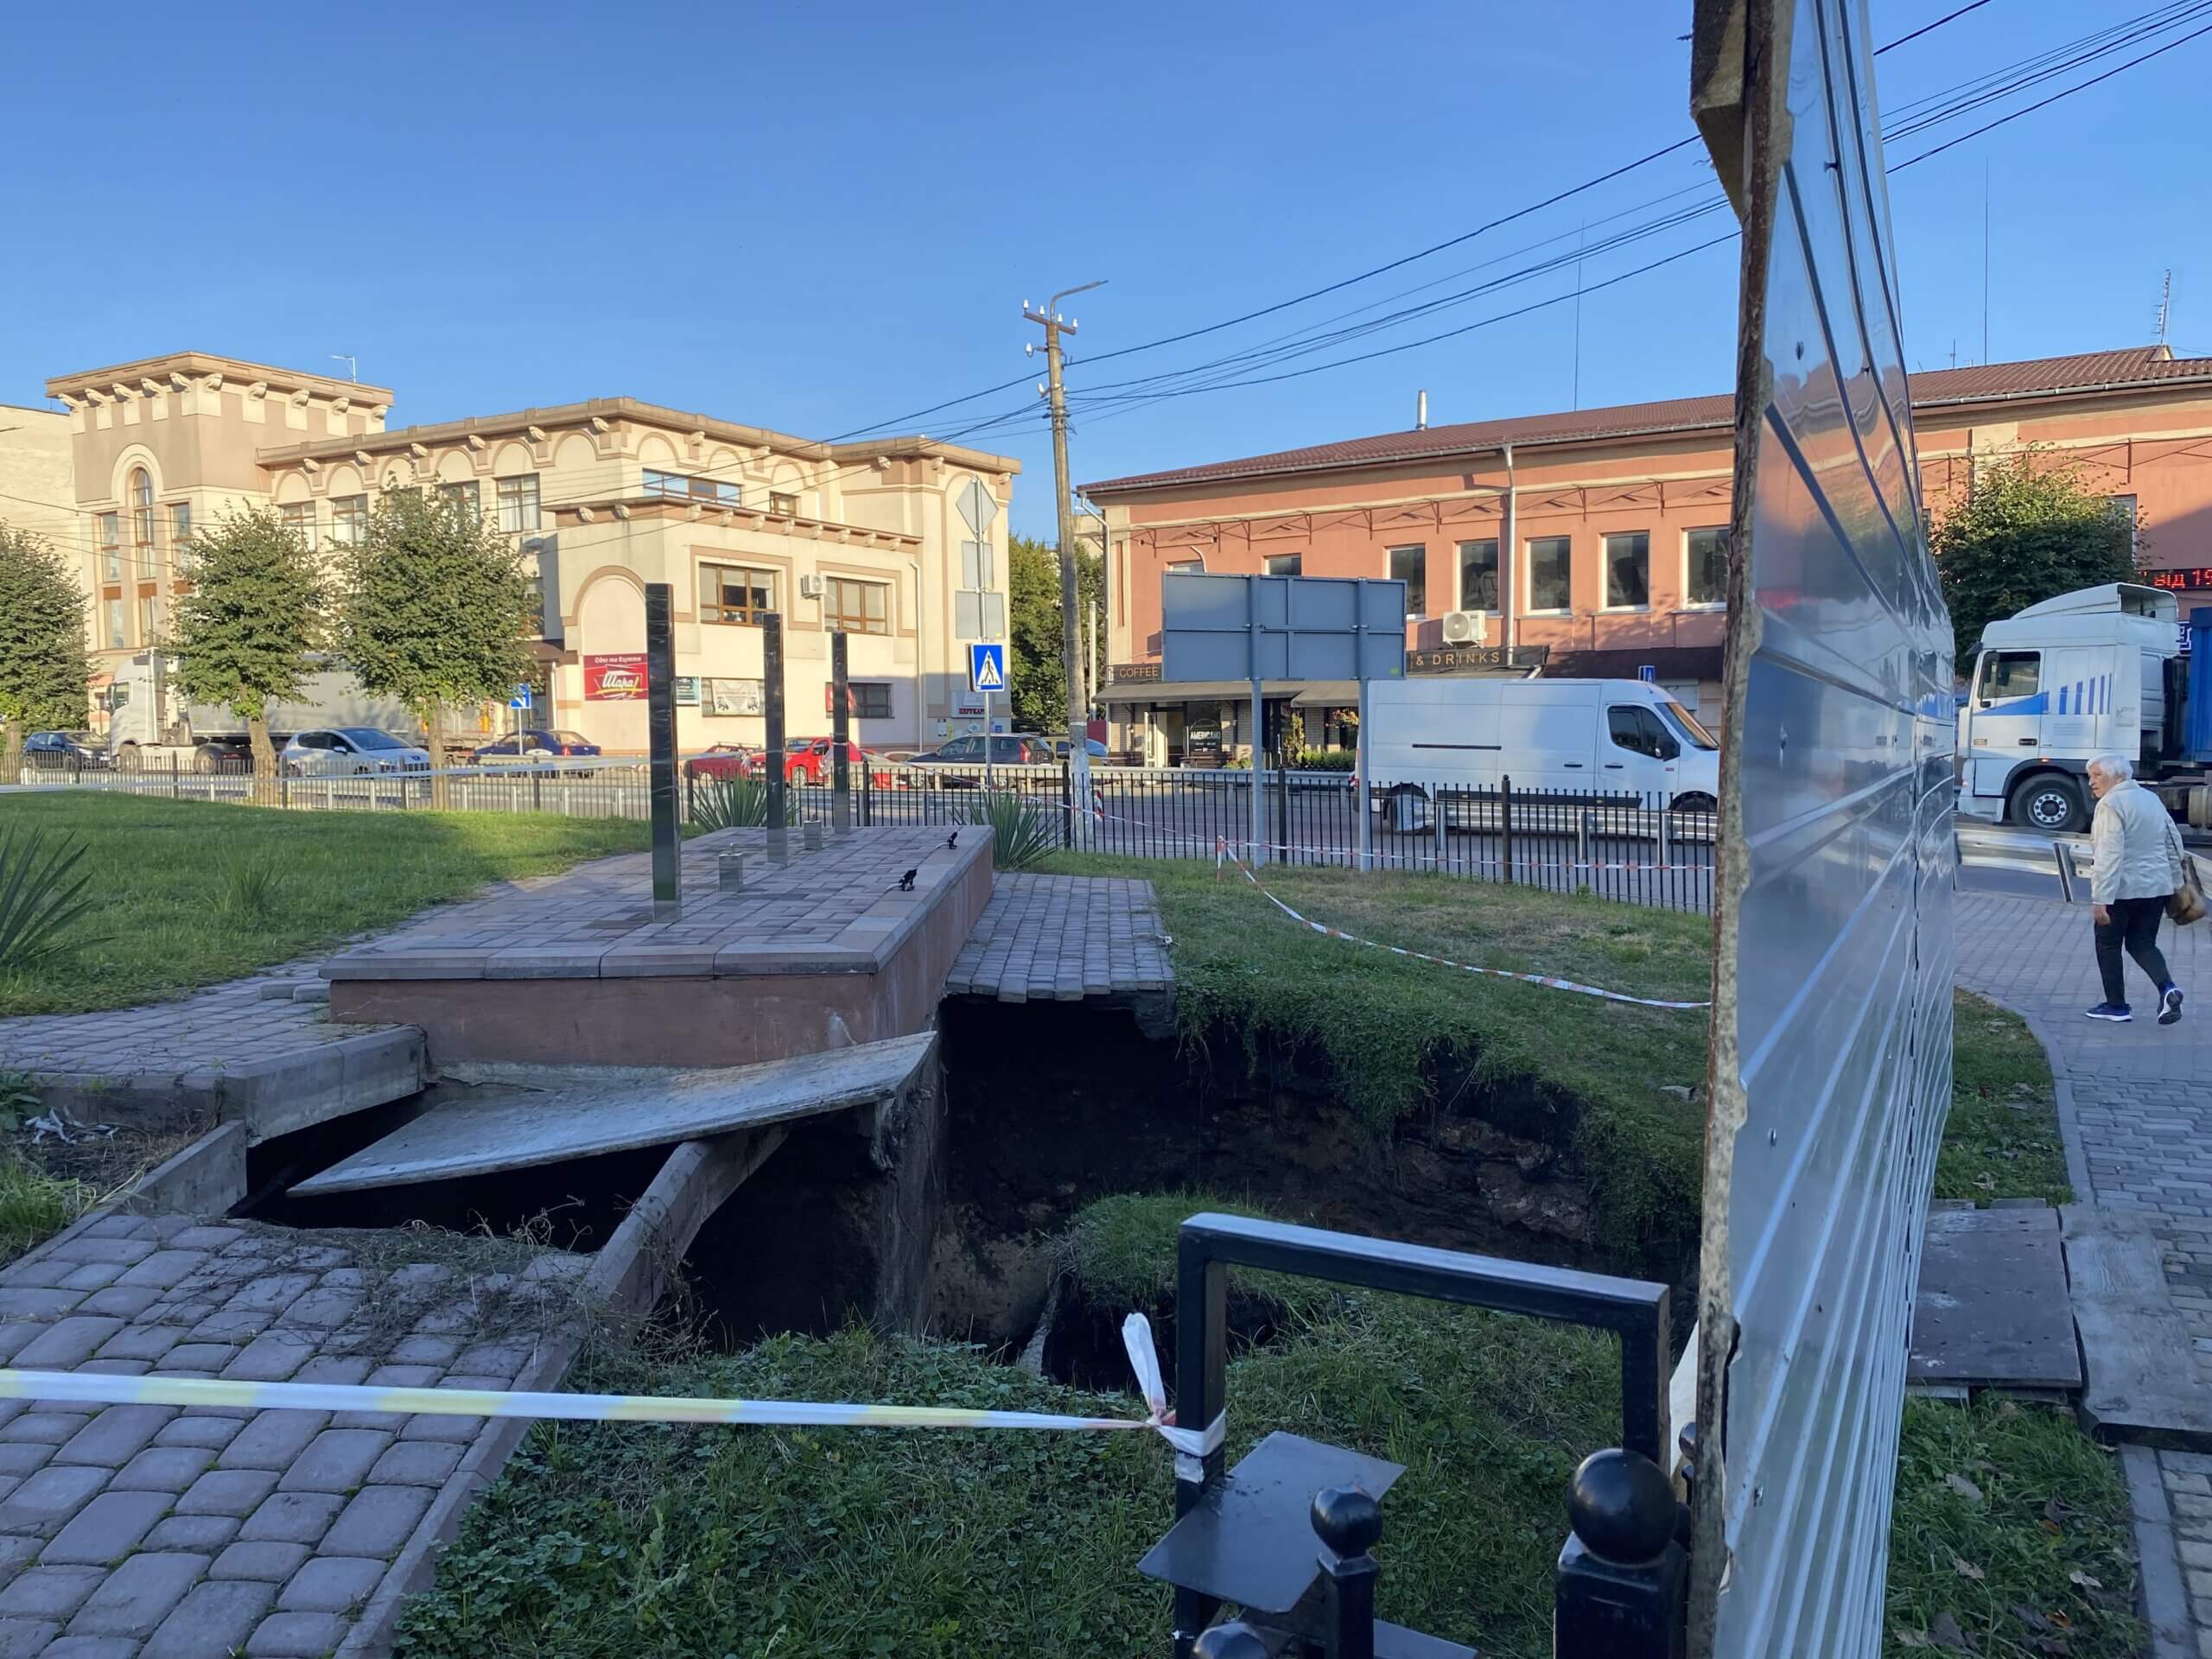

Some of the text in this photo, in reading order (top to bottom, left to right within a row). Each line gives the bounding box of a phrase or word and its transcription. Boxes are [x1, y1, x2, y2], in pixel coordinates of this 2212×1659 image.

[1415, 652, 1500, 665] & DRINKS
[1119, 666, 1159, 678] COFFEE
